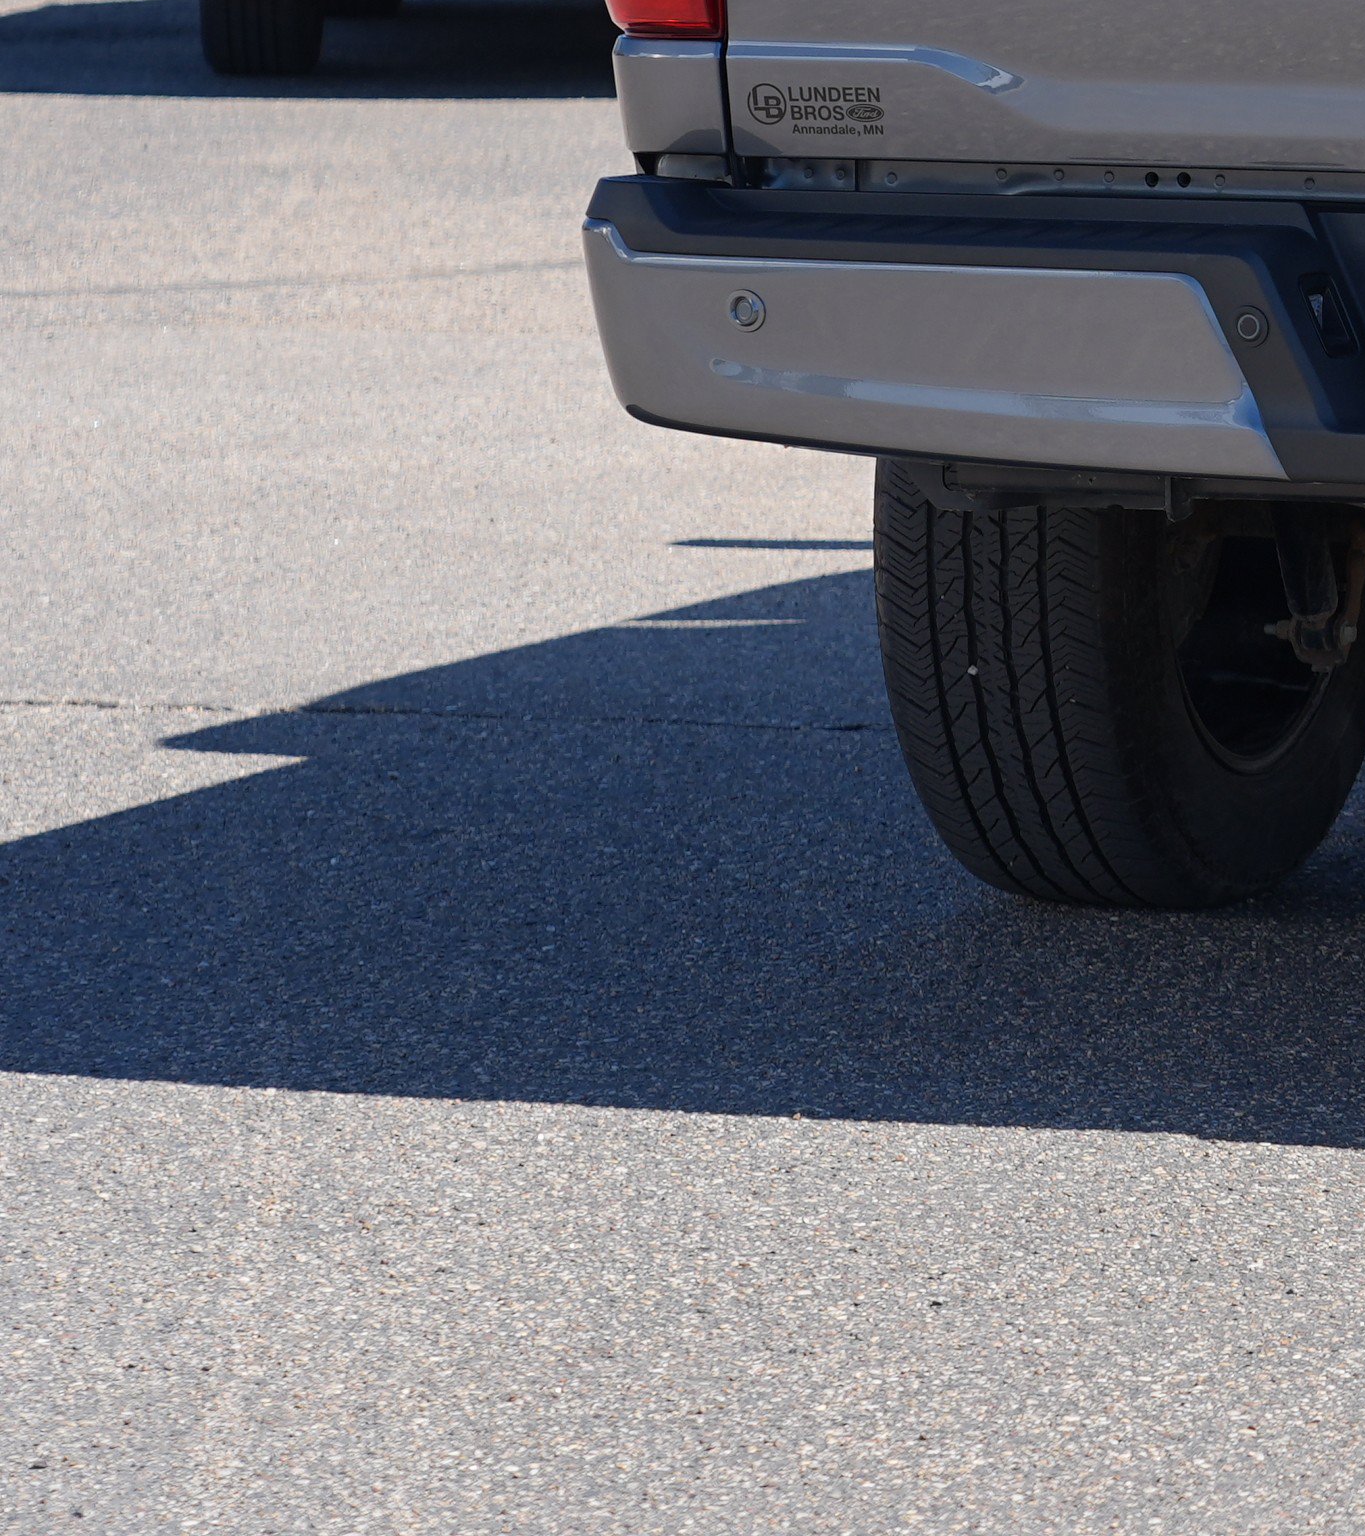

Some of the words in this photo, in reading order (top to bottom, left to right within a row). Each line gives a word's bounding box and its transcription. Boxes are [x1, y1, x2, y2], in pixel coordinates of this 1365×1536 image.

[787, 86, 881, 103] LUNDEEN
[790, 105, 845, 121] BROS
[792, 124, 861, 136] Annandale,
[863, 125, 884, 135] MN
